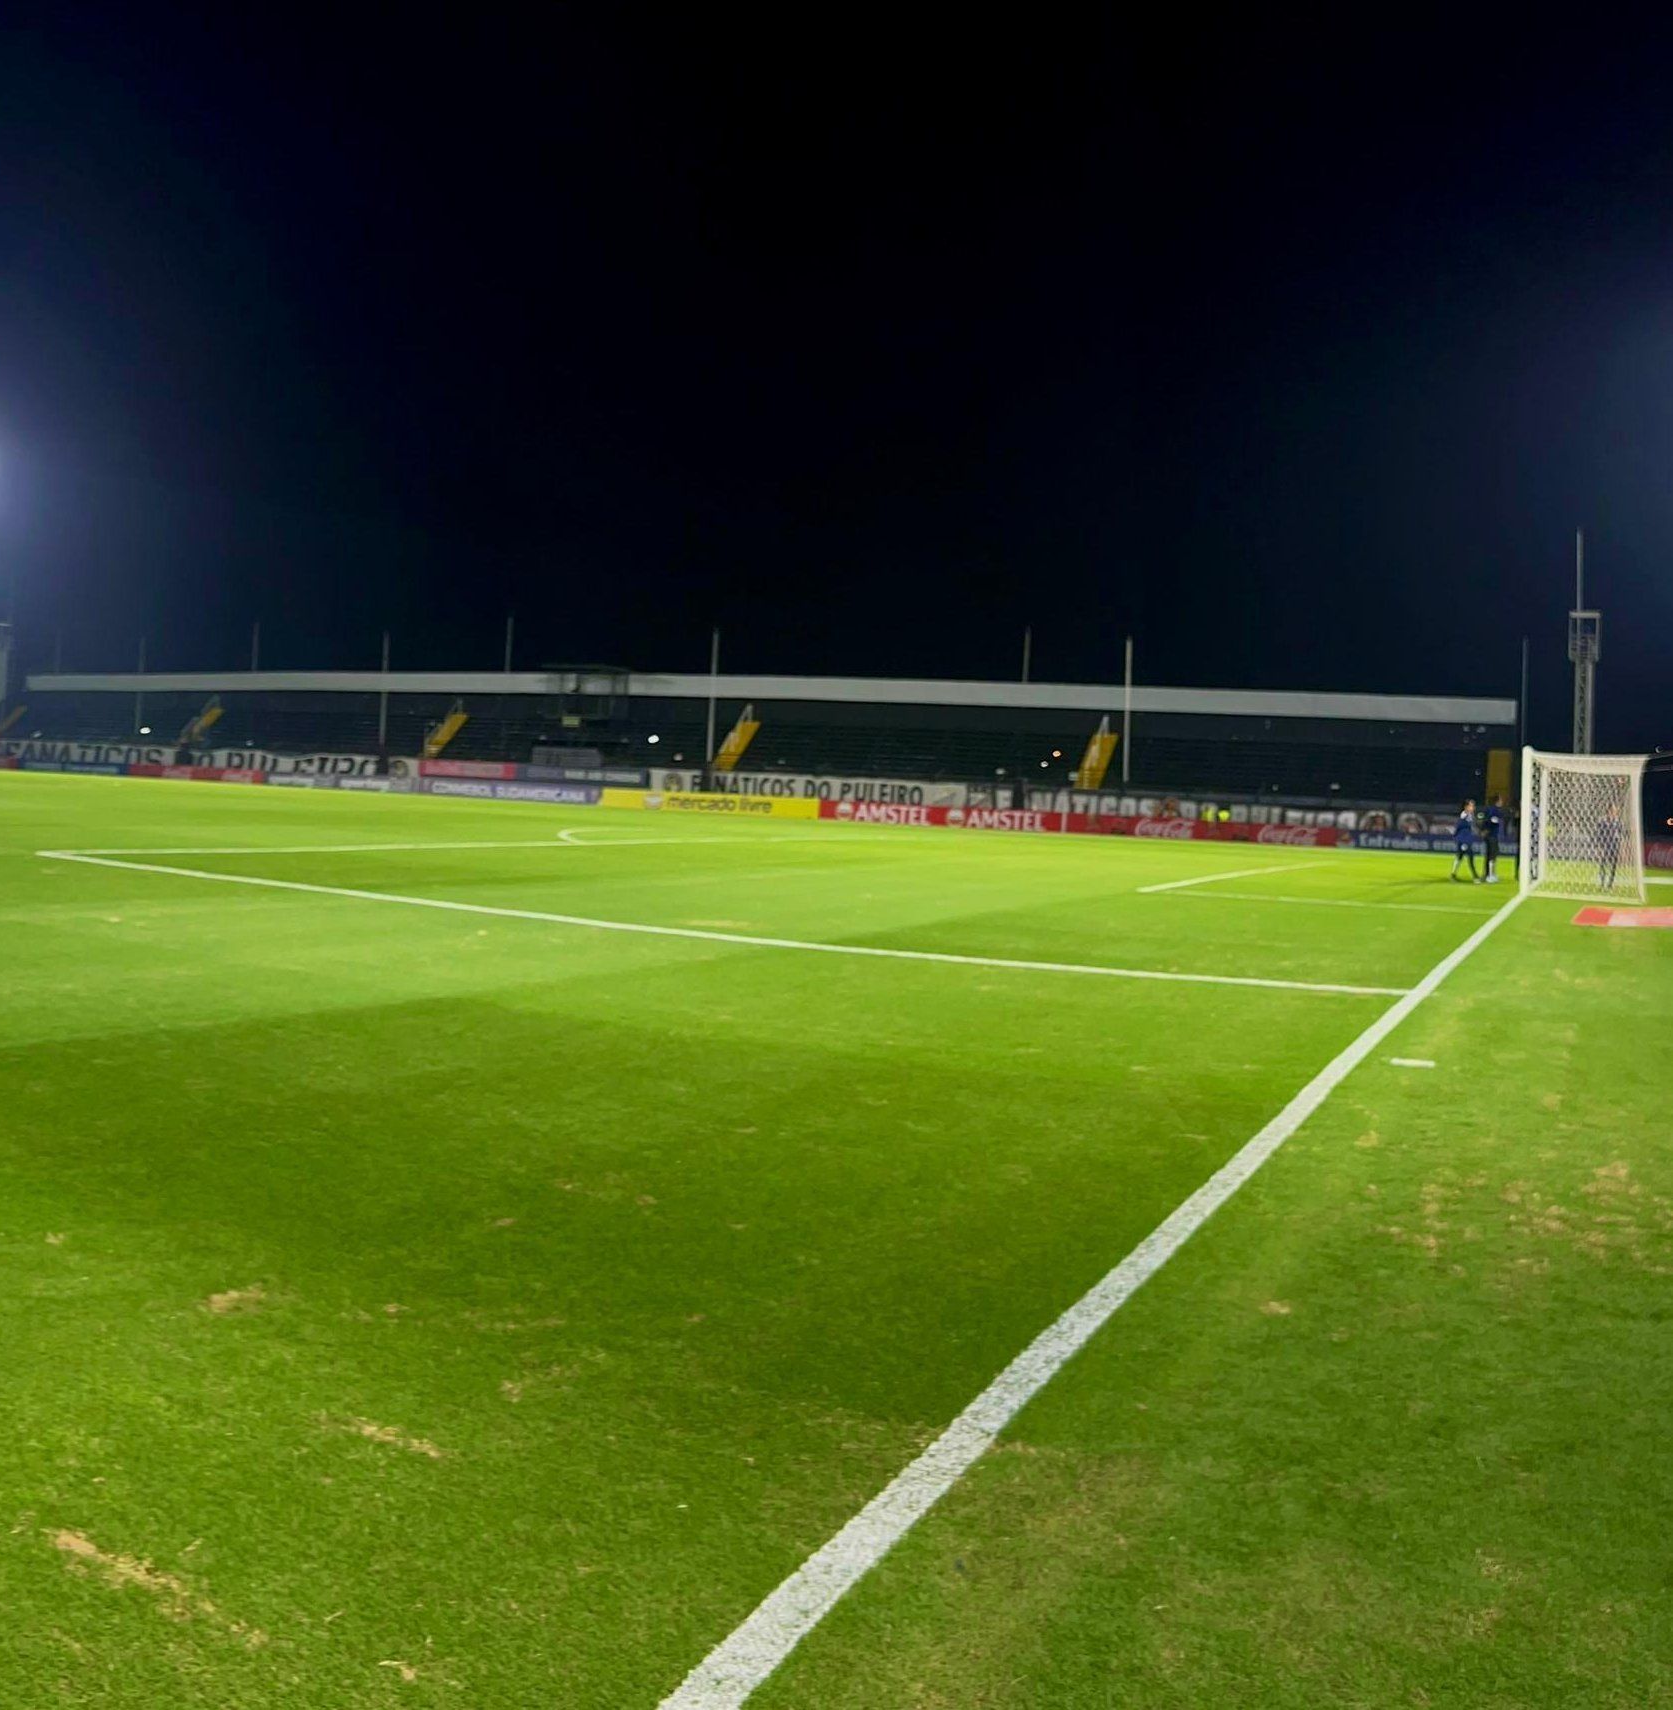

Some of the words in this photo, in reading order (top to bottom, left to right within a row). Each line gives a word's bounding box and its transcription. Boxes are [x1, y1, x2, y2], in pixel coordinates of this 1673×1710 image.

[839, 781, 924, 806] PULEIRO
[667, 796, 735, 812] mercado
[739, 797, 773, 814] livre
[854, 803, 930, 825] AMSTEL
[967, 809, 1045, 832] AMSTEL
[1135, 818, 1195, 840] Coca-Cola
[1258, 824, 1319, 846] Coca-Cola
